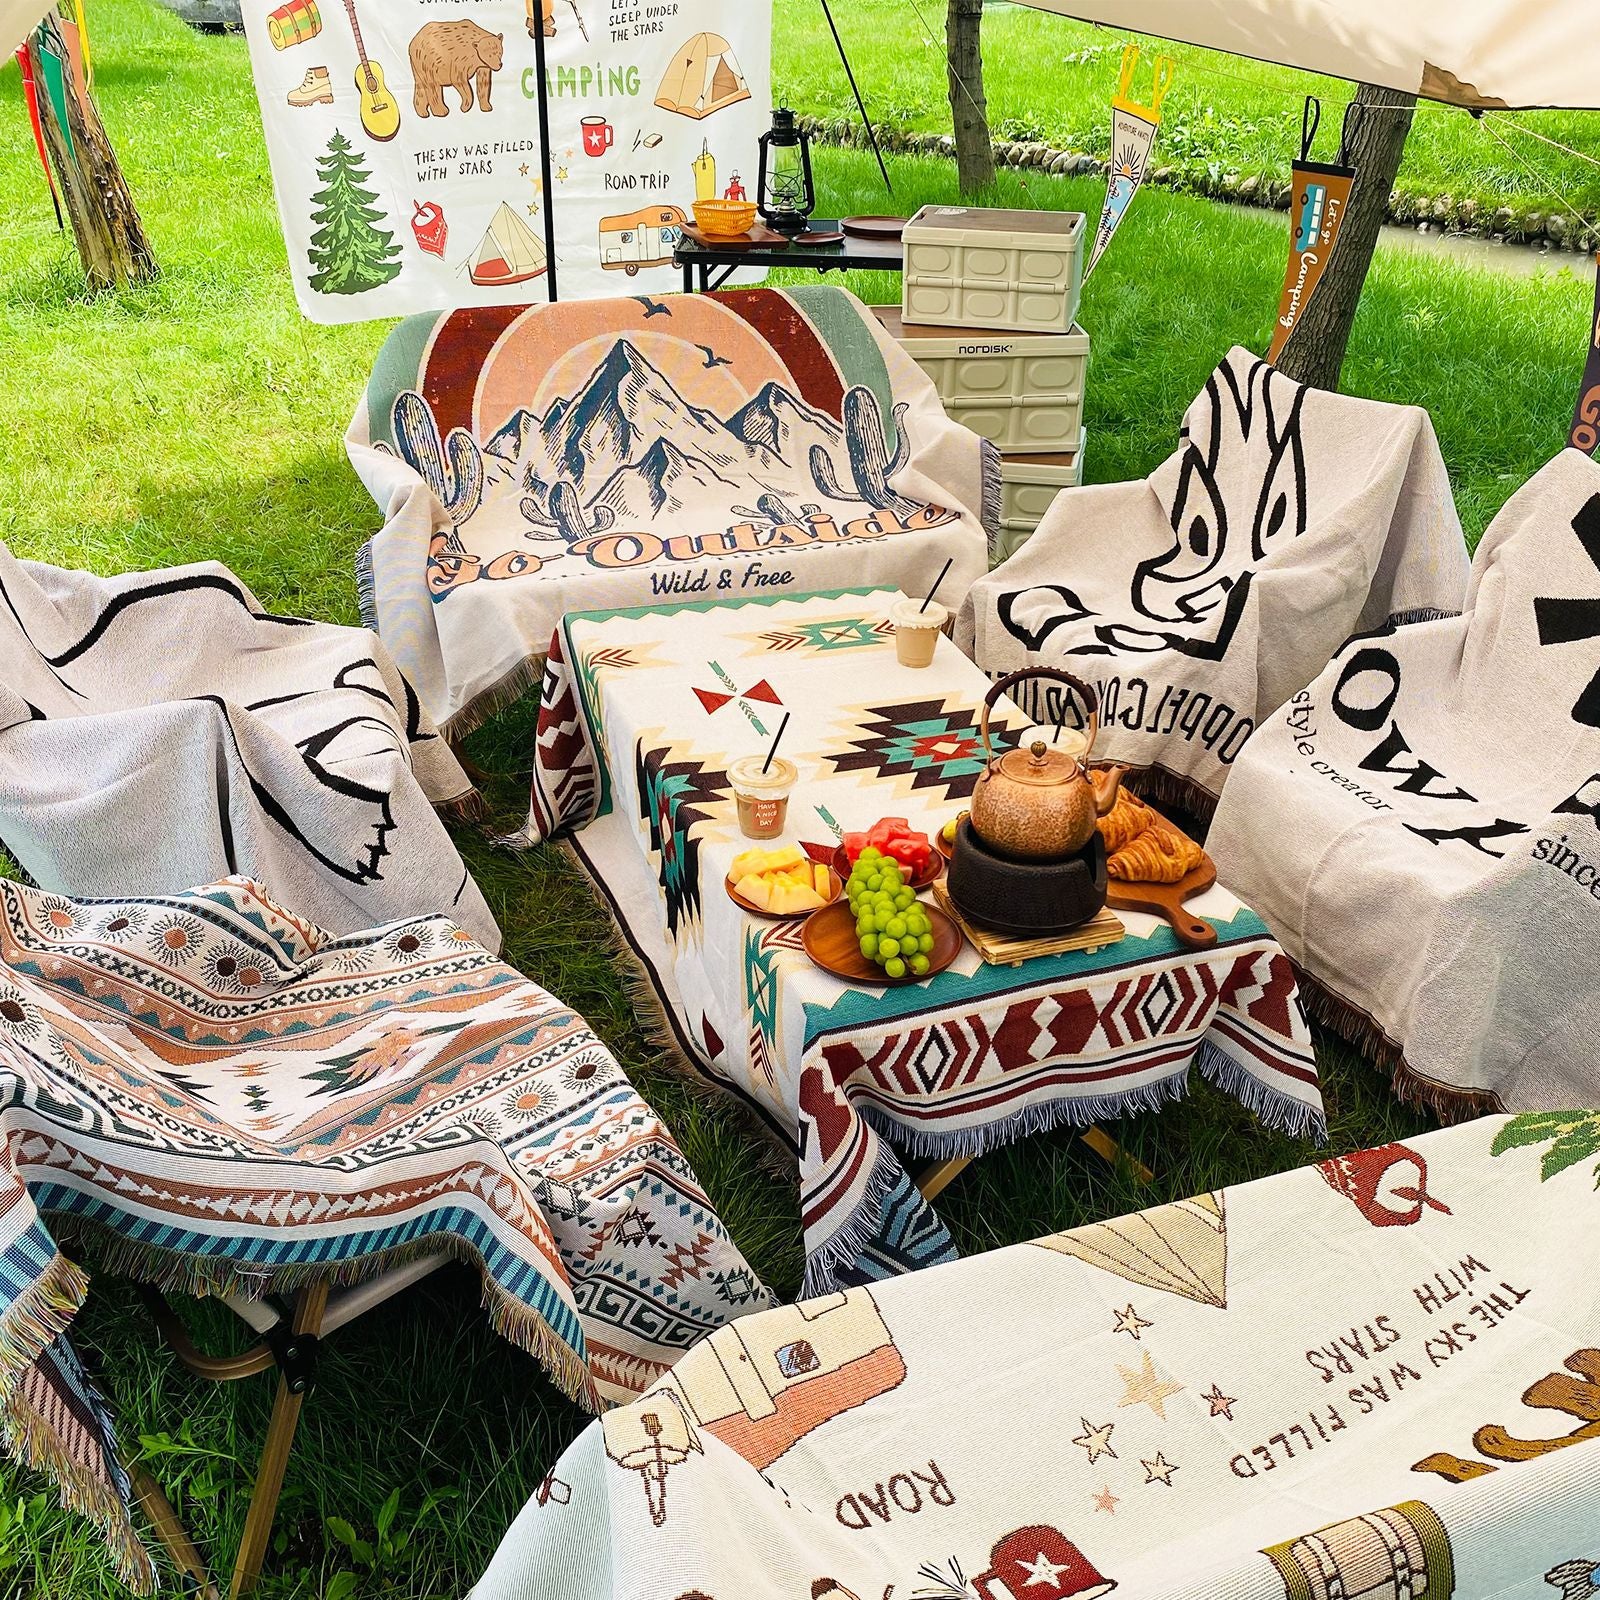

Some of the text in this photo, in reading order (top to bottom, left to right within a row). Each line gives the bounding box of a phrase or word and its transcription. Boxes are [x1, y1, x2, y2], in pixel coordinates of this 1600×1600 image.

[609, 3, 679, 27] SLEEP UNDER
[610, 21, 664, 43] THE STARS
[414, 151, 436, 166] THE
[438, 147, 458, 161] SKY
[464, 143, 489, 157] WAS
[459, 160, 493, 175] STARS
[604, 173, 637, 191] ROAD
[1320, 230, 1331, 246] go
[1279, 251, 1319, 329] Camping
[426, 532, 565, 603] Go
[565, 504, 961, 569] Outside
[649, 563, 796, 596] Wild & Free
[1286, 690, 1394, 810] style creator
[757, 802, 777, 811] HAVE
[762, 810, 778, 818] NICE
[759, 819, 773, 827] DAY
[1468, 1282, 1532, 1329] THE
[1305, 1314, 1401, 1384] STARS
[1424, 1322, 1477, 1368] SKY
[1348, 1360, 1422, 1414] WAS
[835, 1459, 957, 1530] ROAD
